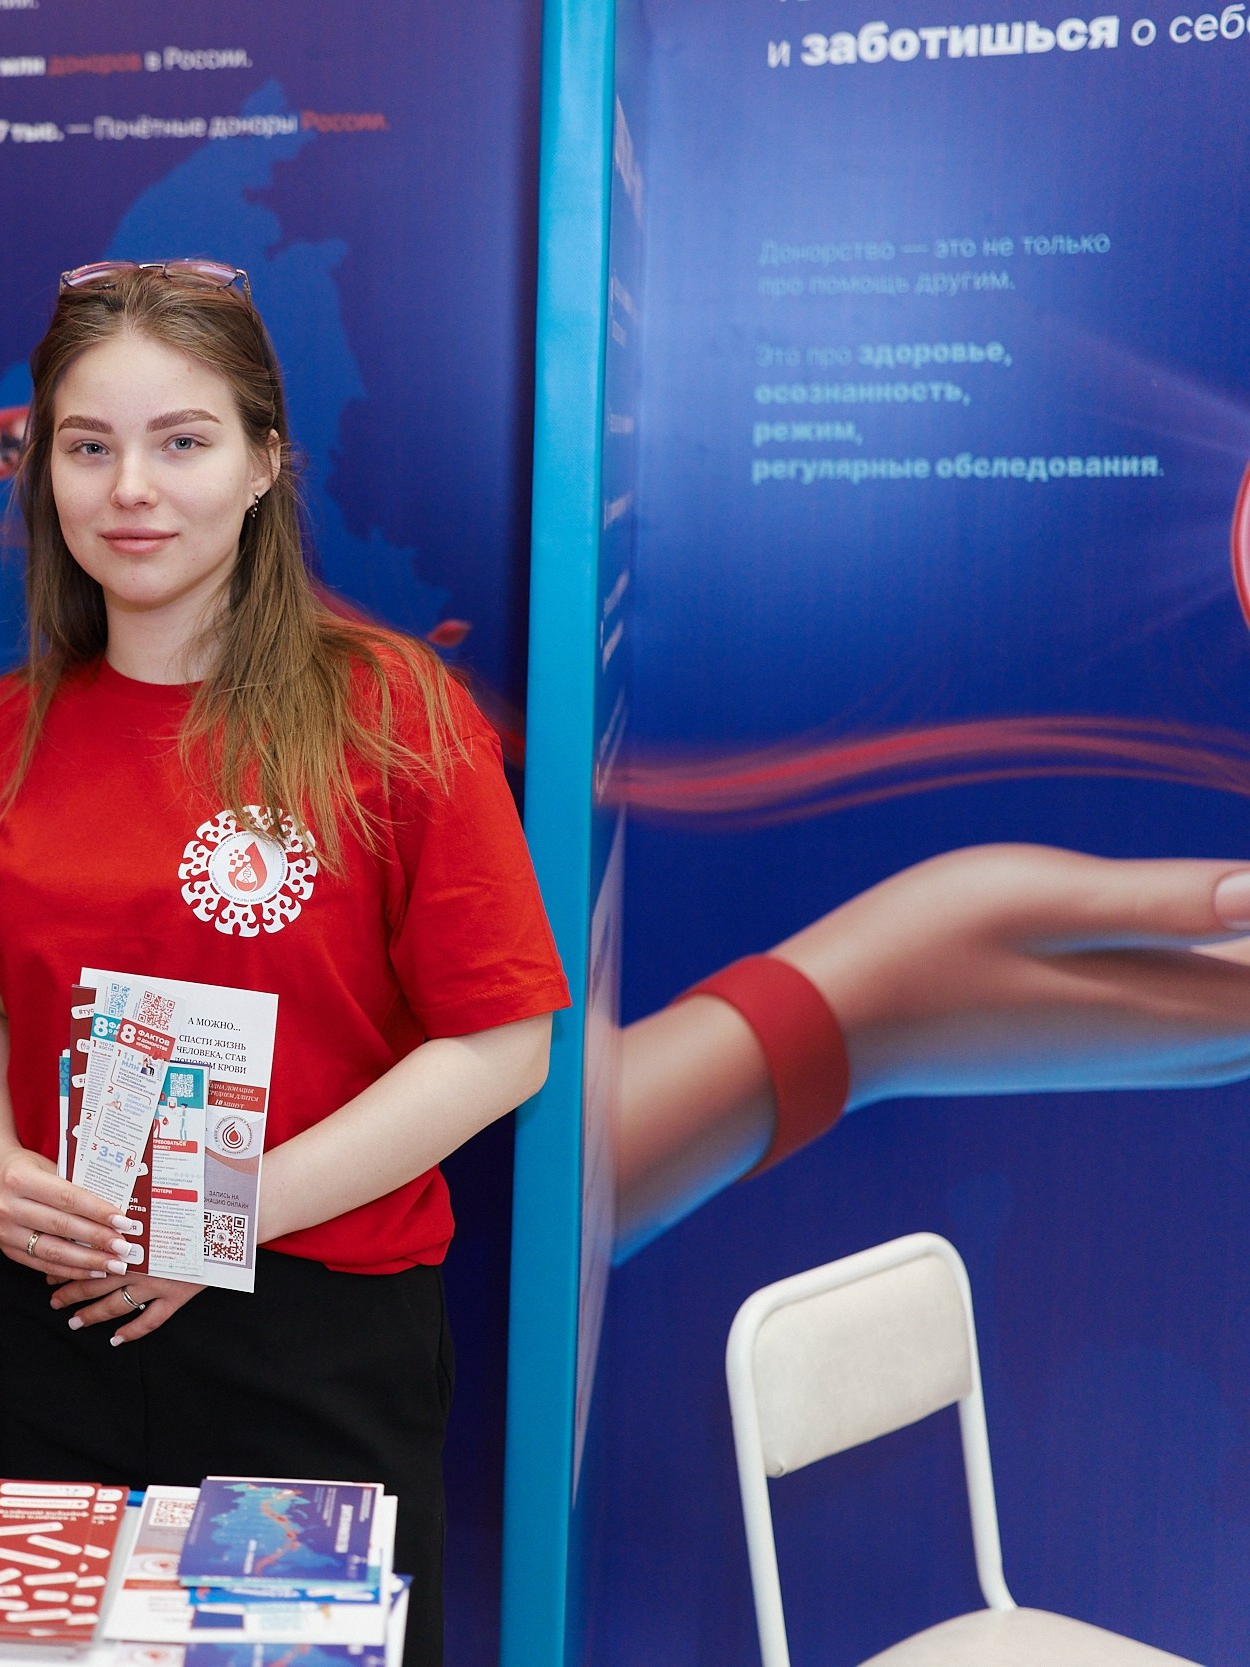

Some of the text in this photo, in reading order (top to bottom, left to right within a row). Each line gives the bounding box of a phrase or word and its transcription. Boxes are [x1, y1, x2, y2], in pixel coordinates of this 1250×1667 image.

[767, 40, 792, 68] и
[800, 15, 1121, 68] заботишься
[1131, 18, 1157, 46] о
[758, 238, 896, 266] Донорство
[934, 238, 977, 260] это
[983, 236, 1015, 257] не
[1022, 233, 1111, 256] только
[758, 271, 1017, 297] про помощь другим.
[756, 341, 1013, 370] Это про здоровье,
[754, 381, 971, 407] осознанность,
[751, 421, 864, 447] режим,
[751, 452, 1166, 485] регулярные обследования.
[94, 1017, 109, 1036] 8
[188, 1017, 194, 1025] А
[120, 1023, 137, 1044] 8
[137, 1029, 171, 1047] ФАКТОВ
[179, 1034, 247, 1051] СПАСТИ ЖИЗНЬ
[176, 1046, 247, 1062] ЧЕЛОВЕКА, СТАВ
[218, 1063, 247, 1074] КРОВИ
[107, 1085, 114, 1094] 2
[225, 1085, 254, 1094] ДОНАЦИЯ
[91, 1142, 98, 1151] 3
[209, 1190, 230, 1199] ЗАПИСЬ
[226, 1200, 249, 1209] ОНЛАЙН
